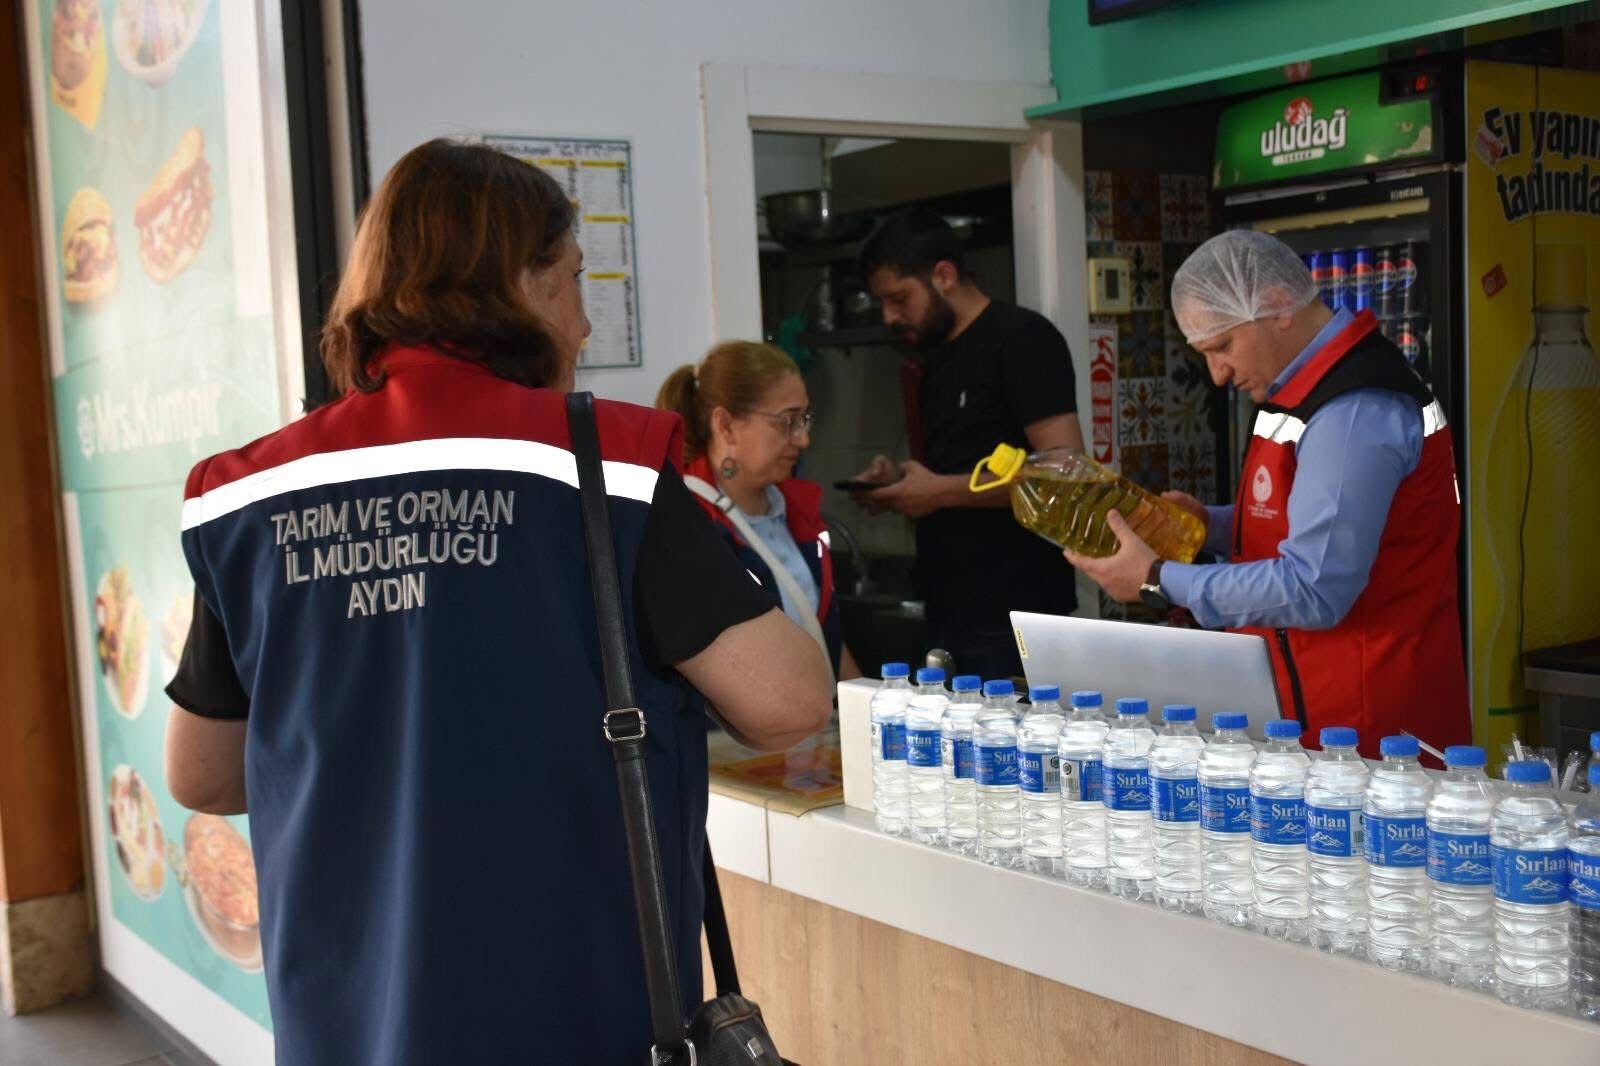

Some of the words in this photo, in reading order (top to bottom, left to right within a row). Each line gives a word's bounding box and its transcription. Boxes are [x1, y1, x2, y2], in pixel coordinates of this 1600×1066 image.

[1261, 108, 1346, 156] uludağ
[1484, 106, 1520, 158] Ev
[1496, 161, 1600, 221] tadında
[271, 501, 350, 545] TARIM
[356, 496, 392, 531] VE
[397, 489, 515, 525] ORMAN
[285, 544, 311, 585] İL
[314, 522, 498, 580] MÜDÜRLÜĞÜ
[347, 571, 426, 619] AYDIN
[1116, 773, 1149, 788] Şırla
[1176, 783, 1197, 799] Şır
[1226, 793, 1248, 809] Şır
[1271, 803, 1306, 821] Şırla
[1387, 823, 1425, 841] Şırla
[1447, 839, 1488, 857] Şırla
